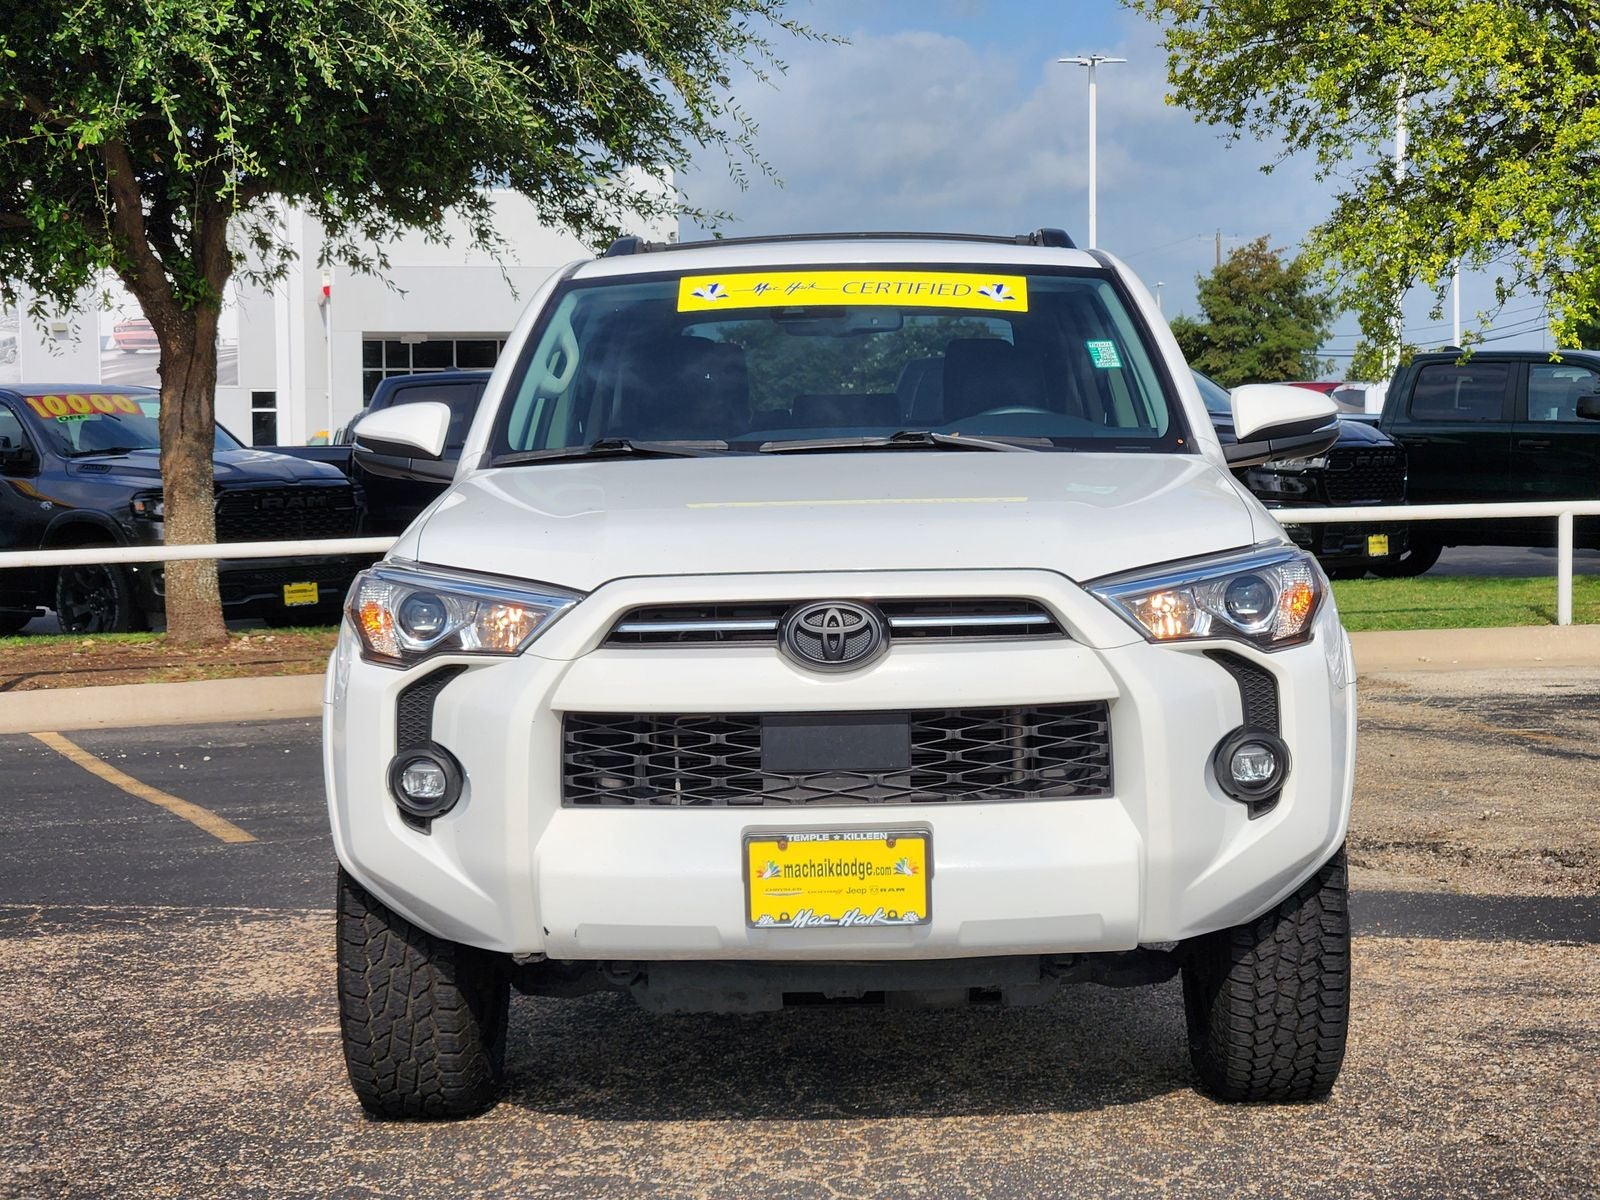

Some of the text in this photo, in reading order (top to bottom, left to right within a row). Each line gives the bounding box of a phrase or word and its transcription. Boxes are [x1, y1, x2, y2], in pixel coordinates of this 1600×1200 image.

[842, 281, 972, 297] CERTIFIED
[26, 394, 138, 418] 10000
[58, 414, 88, 422] OFF
[1356, 455, 1396, 466] RAM
[262, 496, 326, 509] RAM
[787, 832, 888, 842] TEMPLE KILLEEN
[783, 858, 892, 881] machaikdodge.com
[846, 887, 867, 895] Jeep
